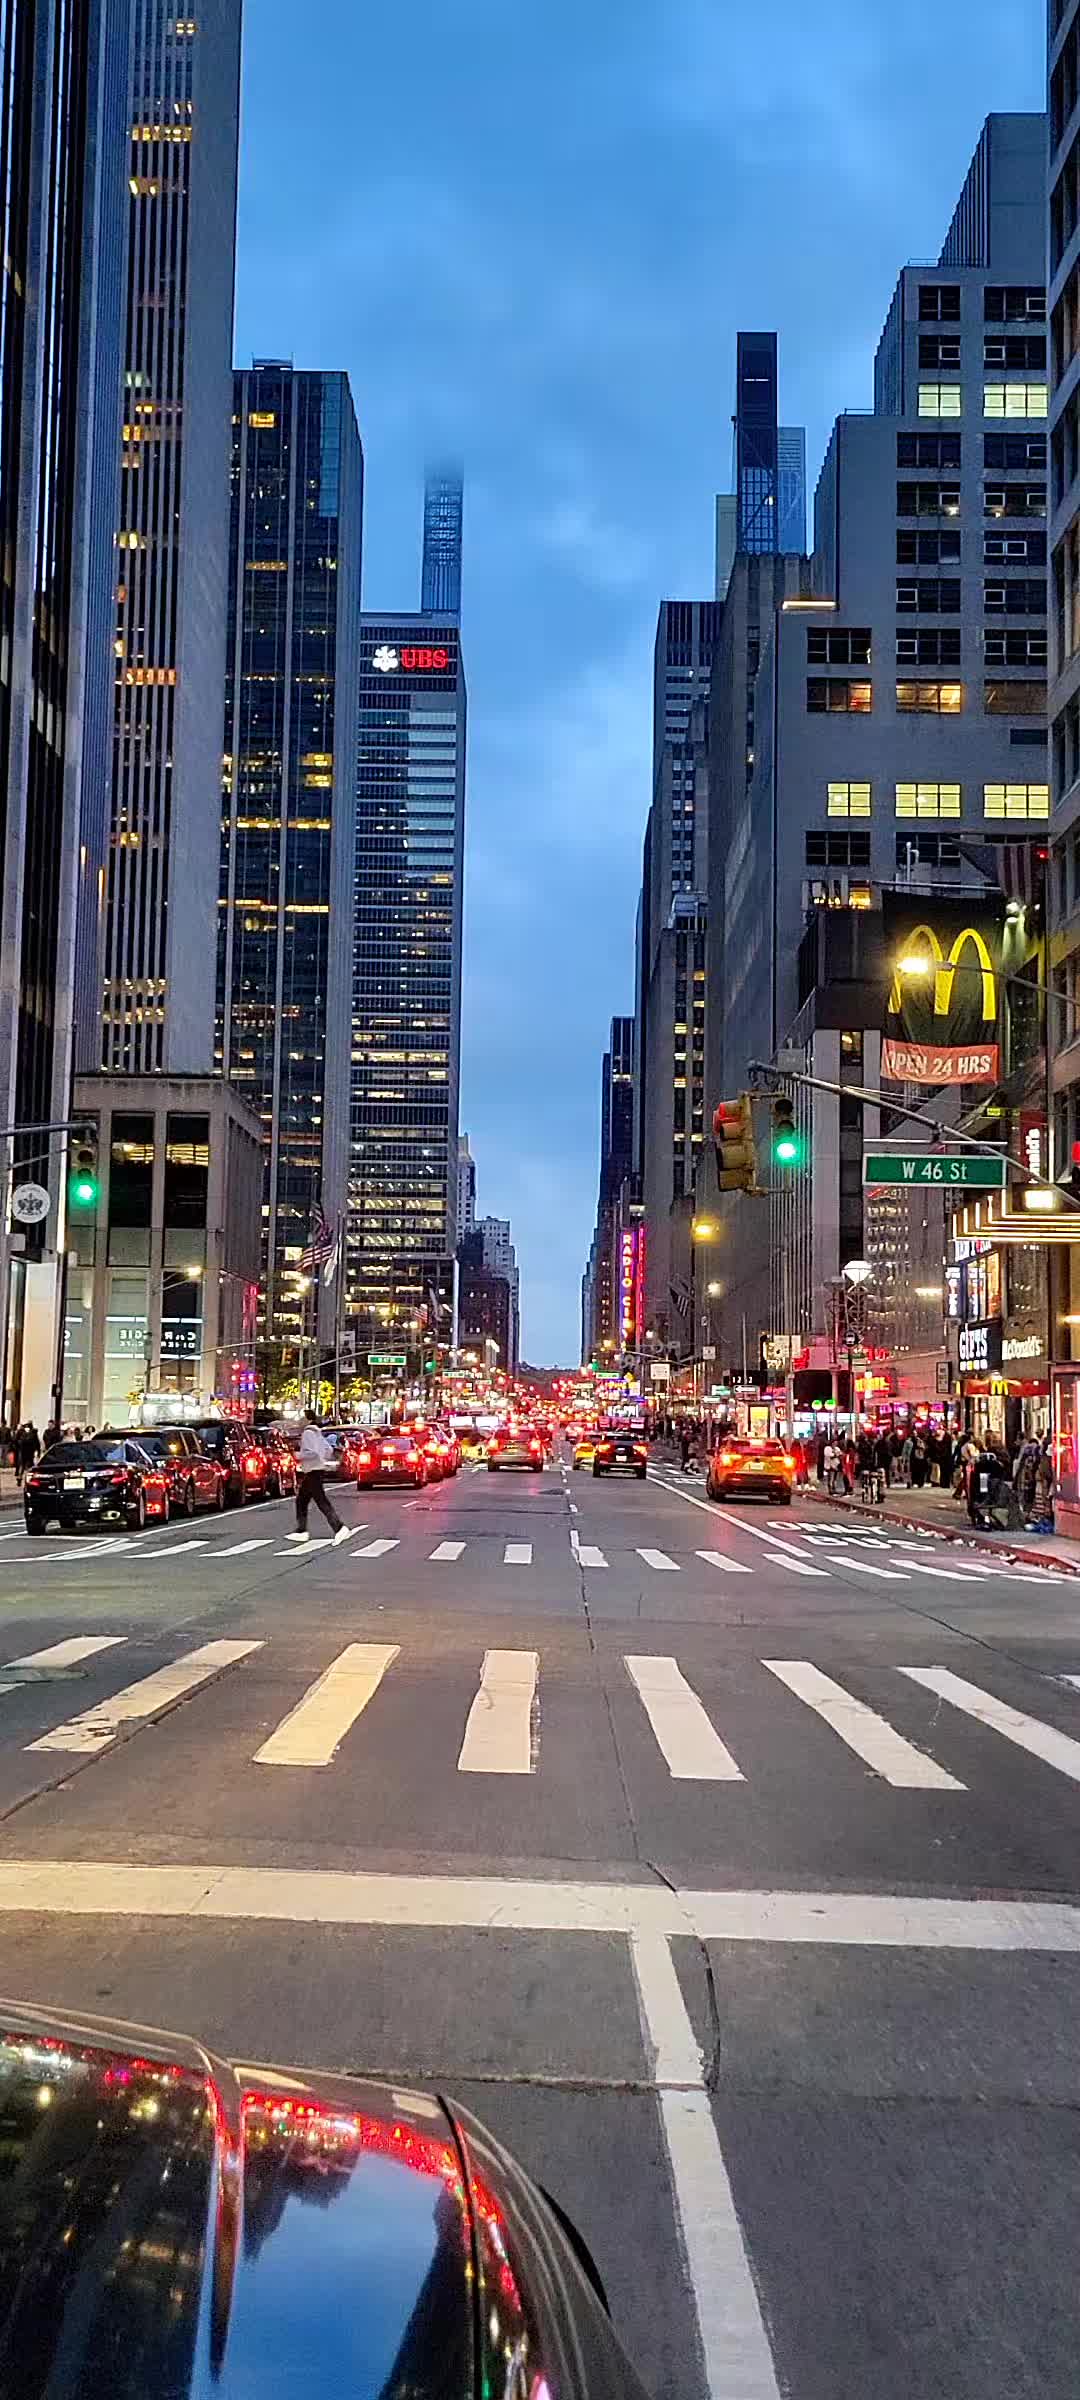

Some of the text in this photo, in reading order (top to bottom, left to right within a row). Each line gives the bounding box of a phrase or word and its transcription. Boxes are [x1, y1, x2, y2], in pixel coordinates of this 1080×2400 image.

[400, 648, 447, 669] UBS
[932, 1058, 953, 1075] 24
[957, 1055, 991, 1075] HRS
[902, 1161, 967, 1180] W 46 St
[622, 1234, 633, 1288] RADIO
[959, 1323, 989, 1360] GIFTS
[765, 1520, 889, 1535] ONLY
[799, 1534, 935, 1552] BUS
